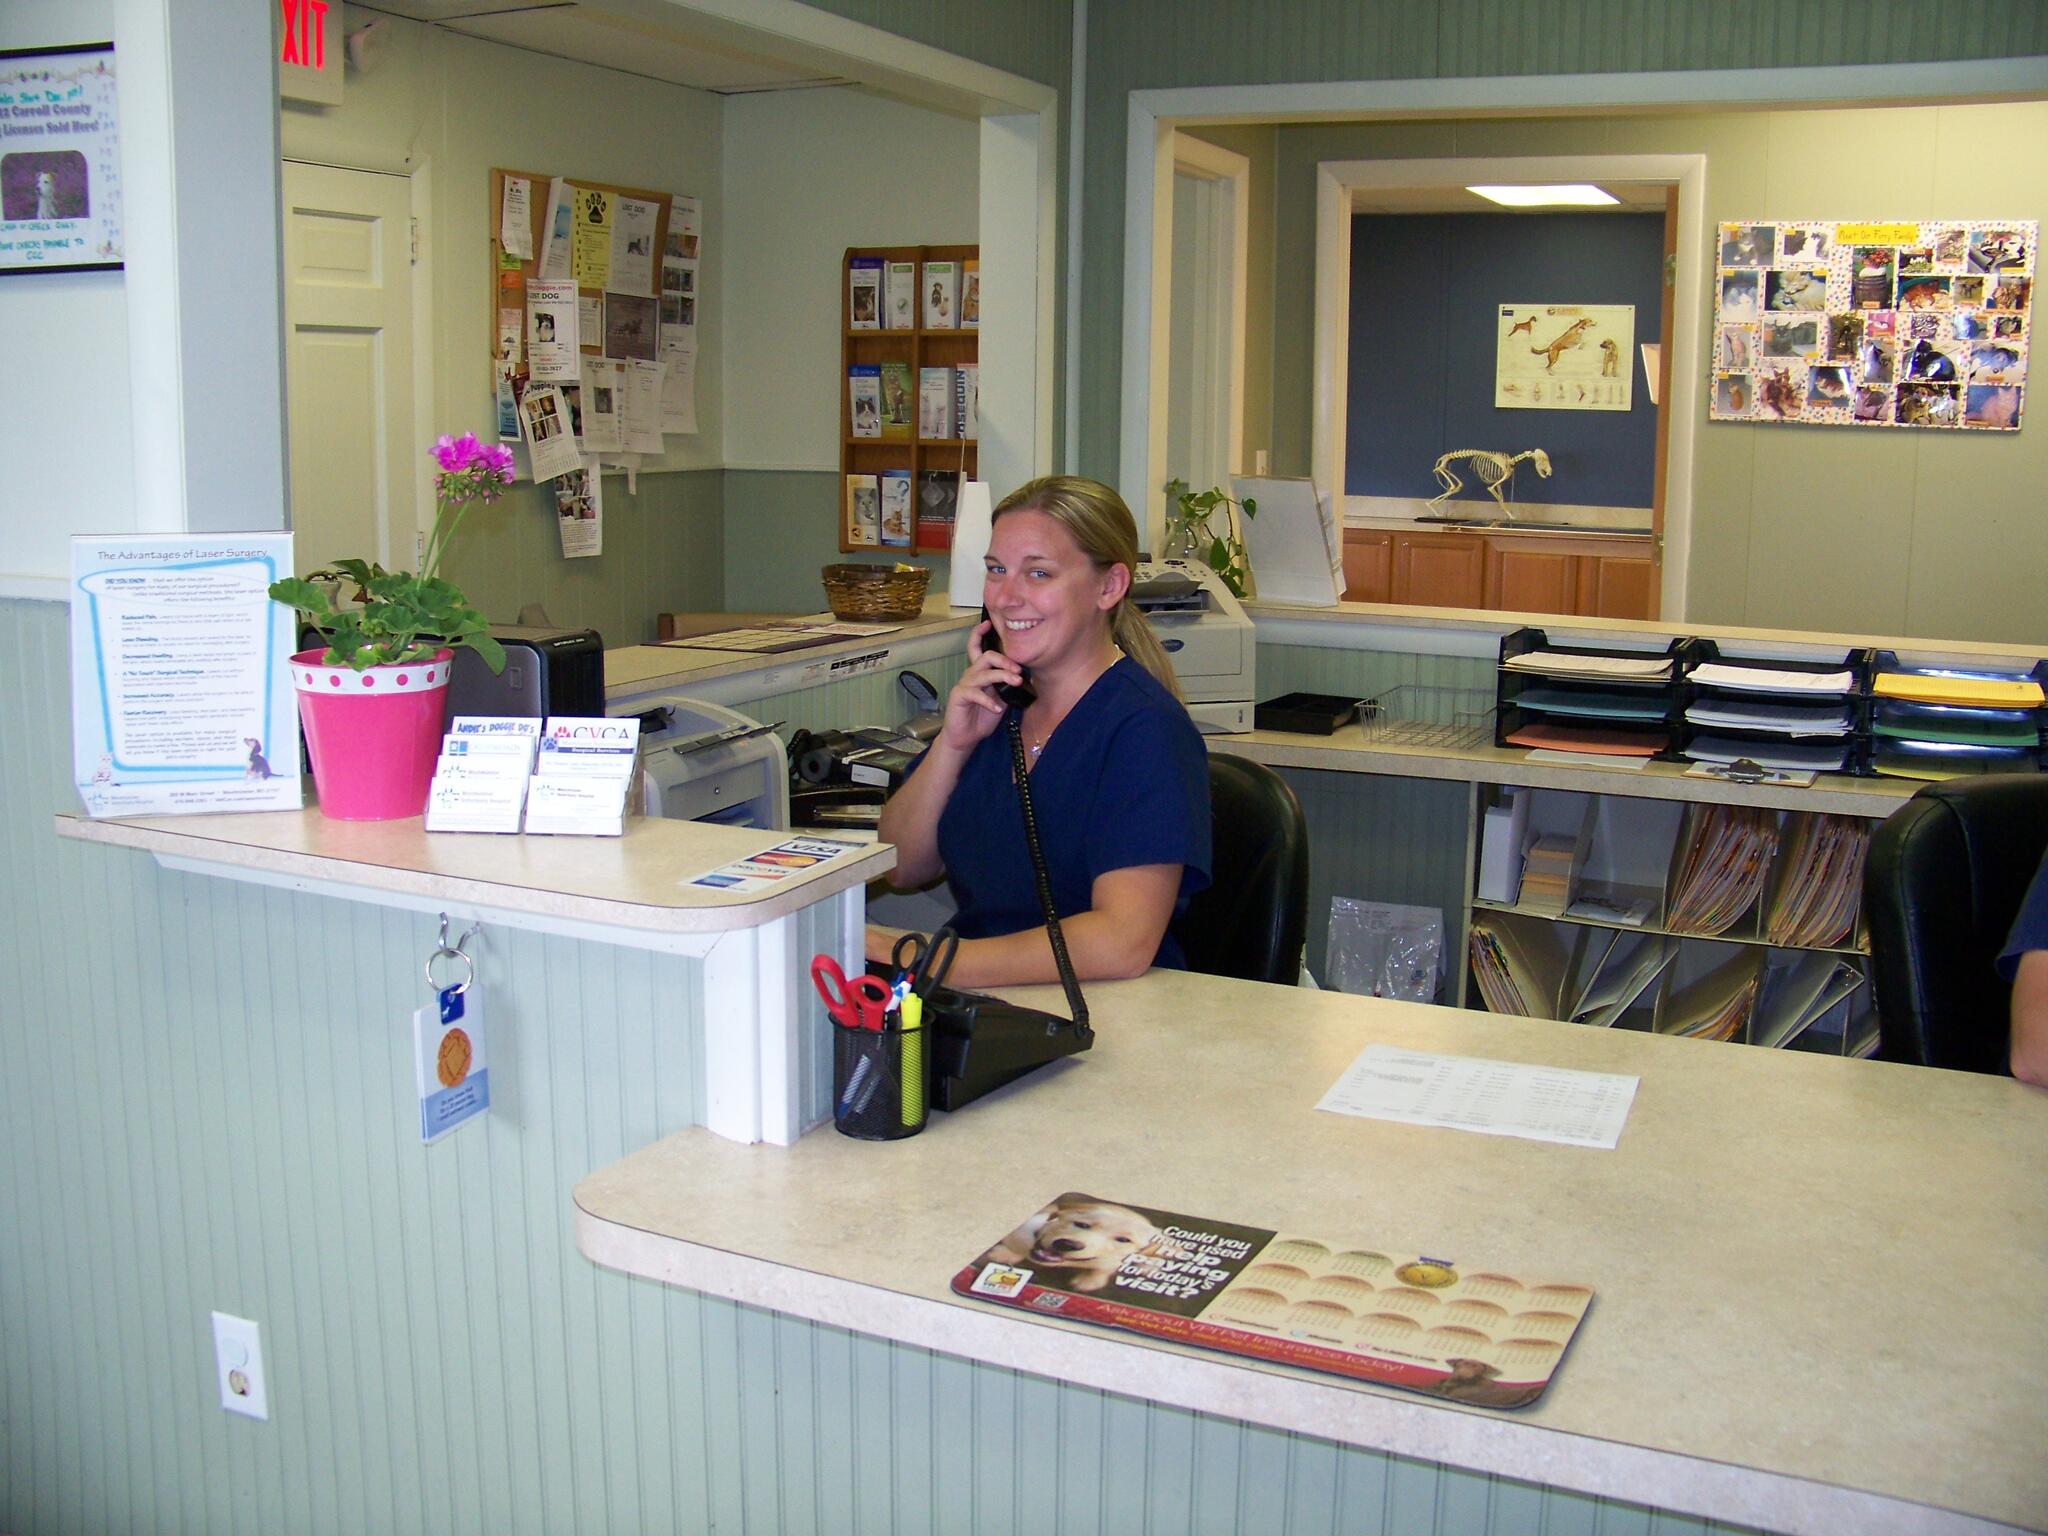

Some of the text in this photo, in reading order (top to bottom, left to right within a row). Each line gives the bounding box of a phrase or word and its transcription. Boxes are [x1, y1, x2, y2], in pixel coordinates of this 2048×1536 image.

[281, 0, 329, 70] XIT
[53, 104, 92, 116] County
[541, 292, 560, 300] DOG
[98, 549, 268, 562] The Advantages of Laser Surgery
[573, 726, 630, 739] CVCA
[791, 844, 843, 854] VISA
[1150, 1232, 1248, 1260] have used
[1163, 1225, 1252, 1251] Could you
[1121, 1252, 1230, 1282] paying
[1156, 1244, 1222, 1267] help
[1114, 1275, 1201, 1299] visit?
[1118, 1260, 1216, 1290] for today's
[1096, 1302, 1130, 1316] Ask
[1134, 1310, 1185, 1327] about
